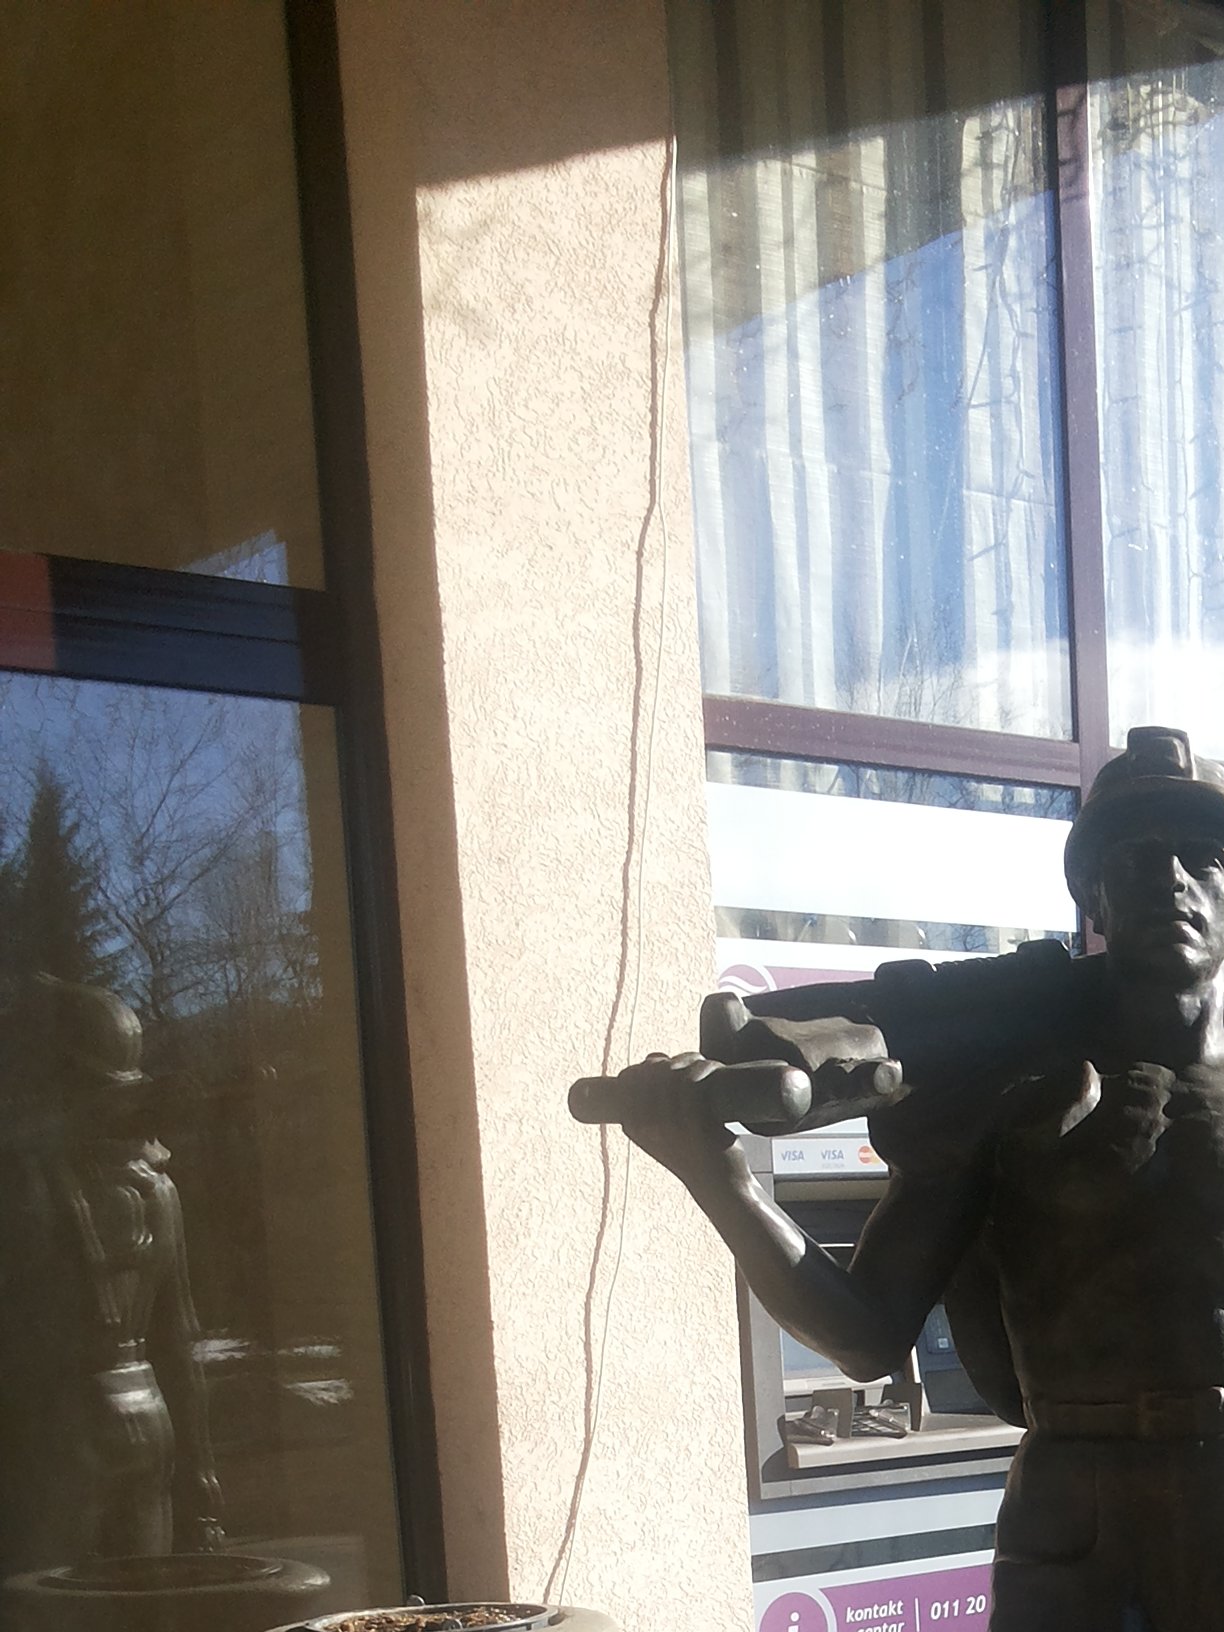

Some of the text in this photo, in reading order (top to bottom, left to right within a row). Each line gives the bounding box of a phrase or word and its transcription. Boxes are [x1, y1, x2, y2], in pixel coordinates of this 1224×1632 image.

[781, 1149, 844, 1160] VISA VISA
[846, 1599, 904, 1623] kontakt
[930, 1595, 987, 1620] 011 20
